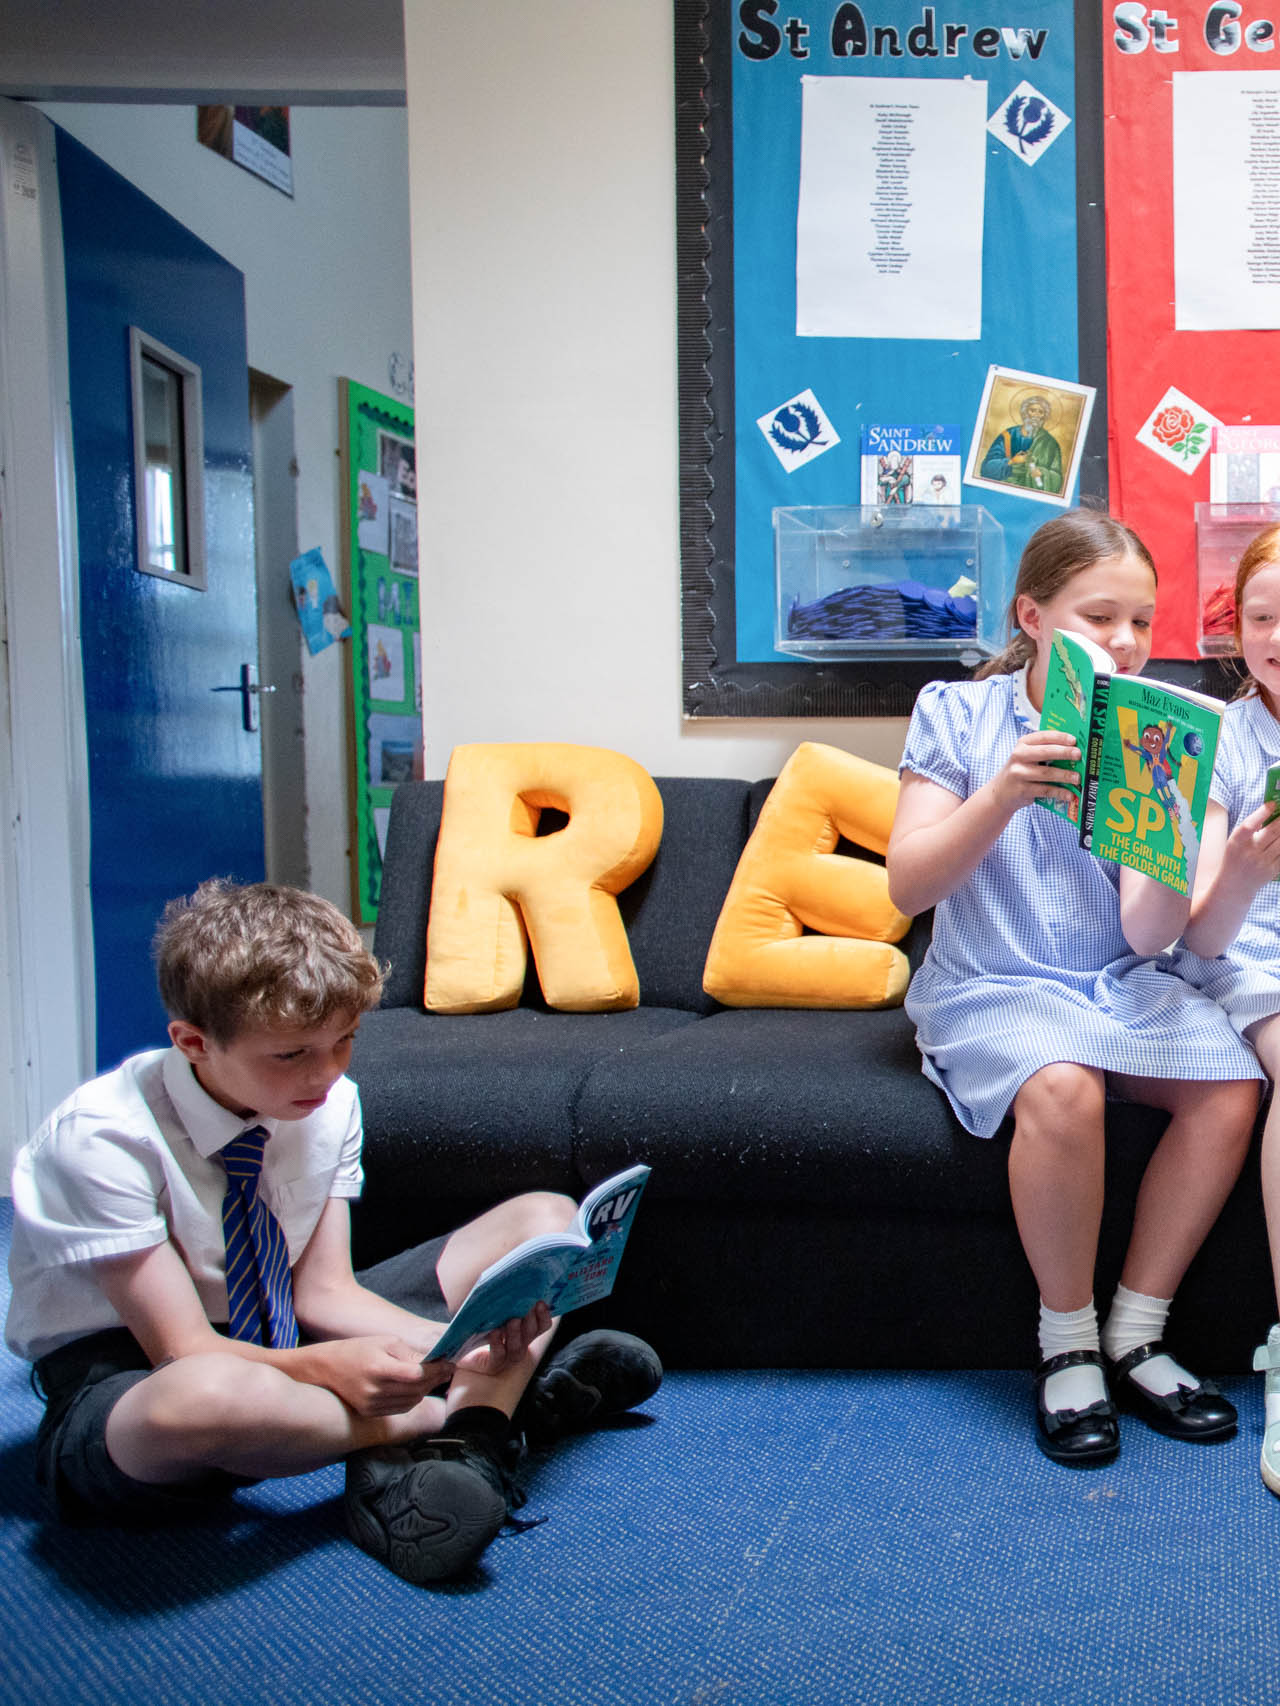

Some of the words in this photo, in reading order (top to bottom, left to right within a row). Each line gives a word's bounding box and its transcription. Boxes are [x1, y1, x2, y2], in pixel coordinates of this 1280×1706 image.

[738, 0, 810, 61] St
[830, 1, 1048, 61] Andrew
[1112, 1, 1180, 54] St
[878, 439, 952, 452] ANDREW
[1095, 687, 1109, 703] VI
[1142, 688, 1160, 707] Maz
[1163, 696, 1190, 720] Evans
[1092, 708, 1107, 738] SPY
[1099, 844, 1119, 860] THE
[1121, 850, 1160, 879] GOLDEN
[1161, 870, 1188, 893] GRAN
[1112, 833, 1130, 850] THE
[1133, 842, 1153, 860] GIRL
[1157, 851, 1181, 874] WITH
